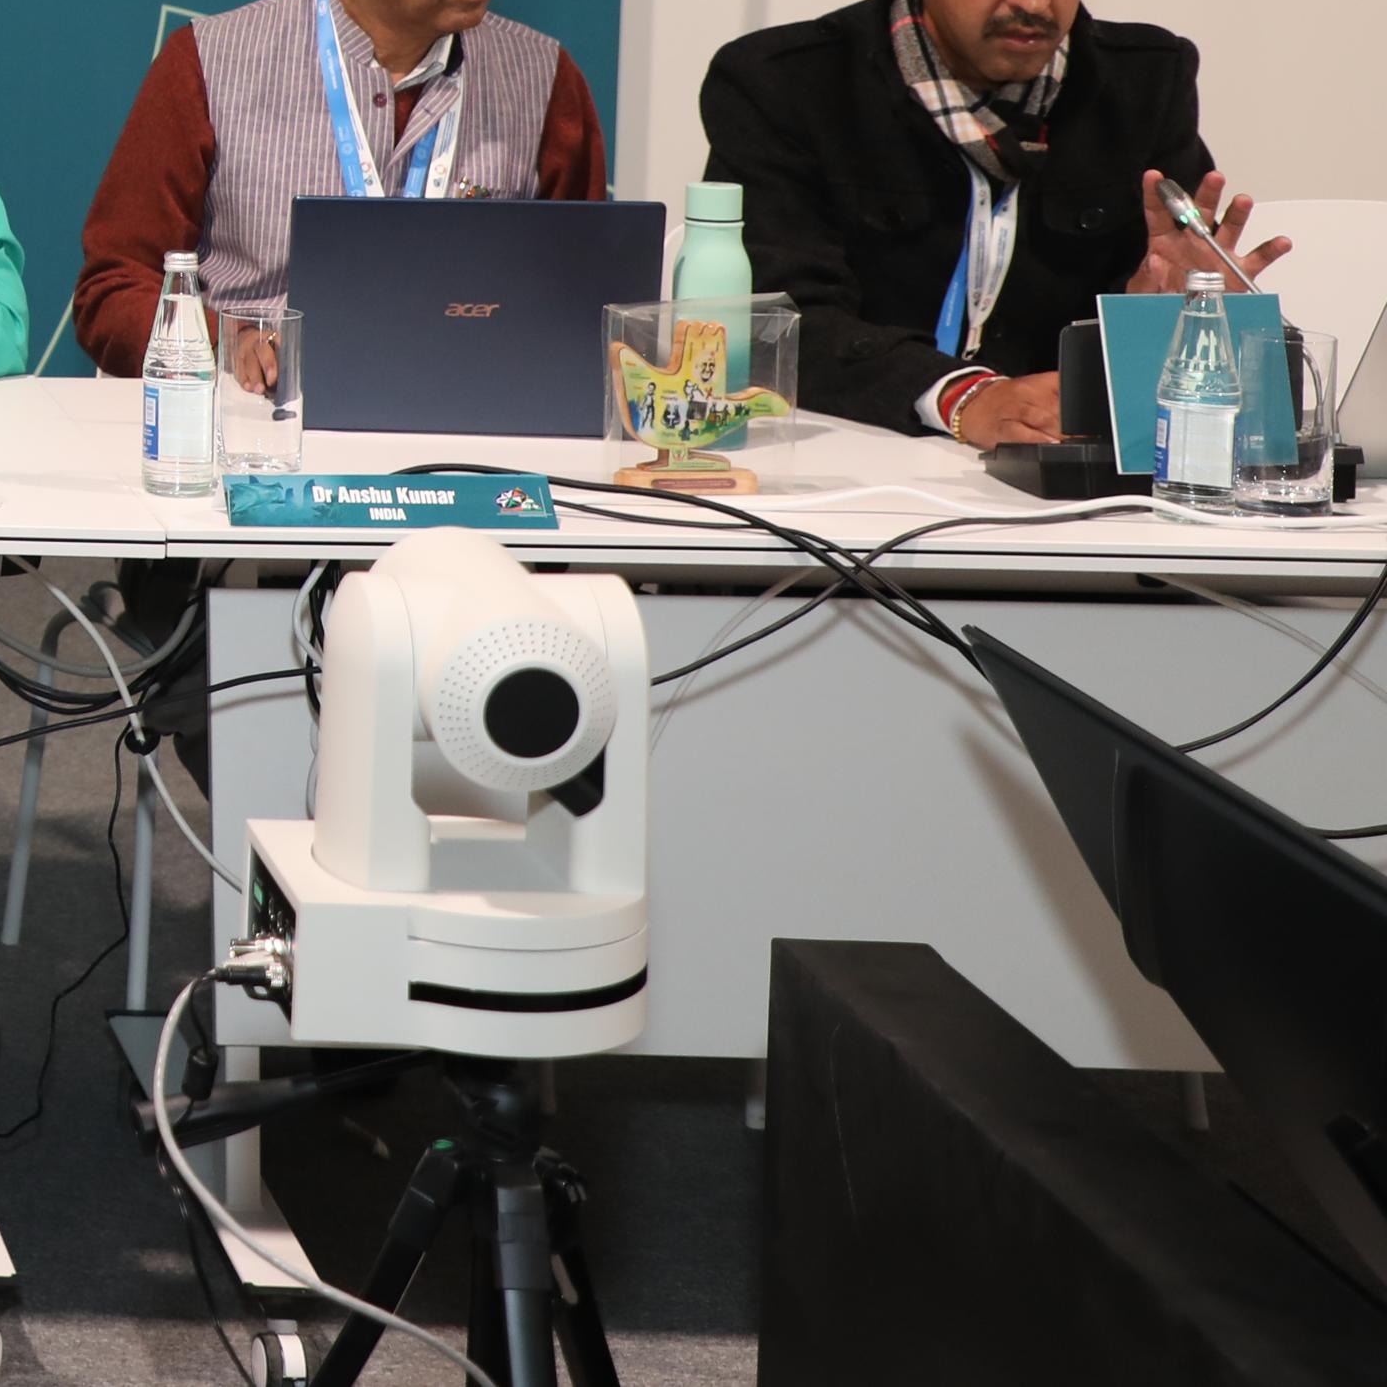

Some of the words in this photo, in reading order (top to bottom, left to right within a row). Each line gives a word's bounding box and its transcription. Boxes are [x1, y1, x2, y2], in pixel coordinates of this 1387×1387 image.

[444, 302, 499, 317] acer
[312, 485, 333, 503] Dr
[337, 486, 393, 504] Anshu
[396, 486, 456, 505] Kumar
[369, 508, 407, 521] INDIA
